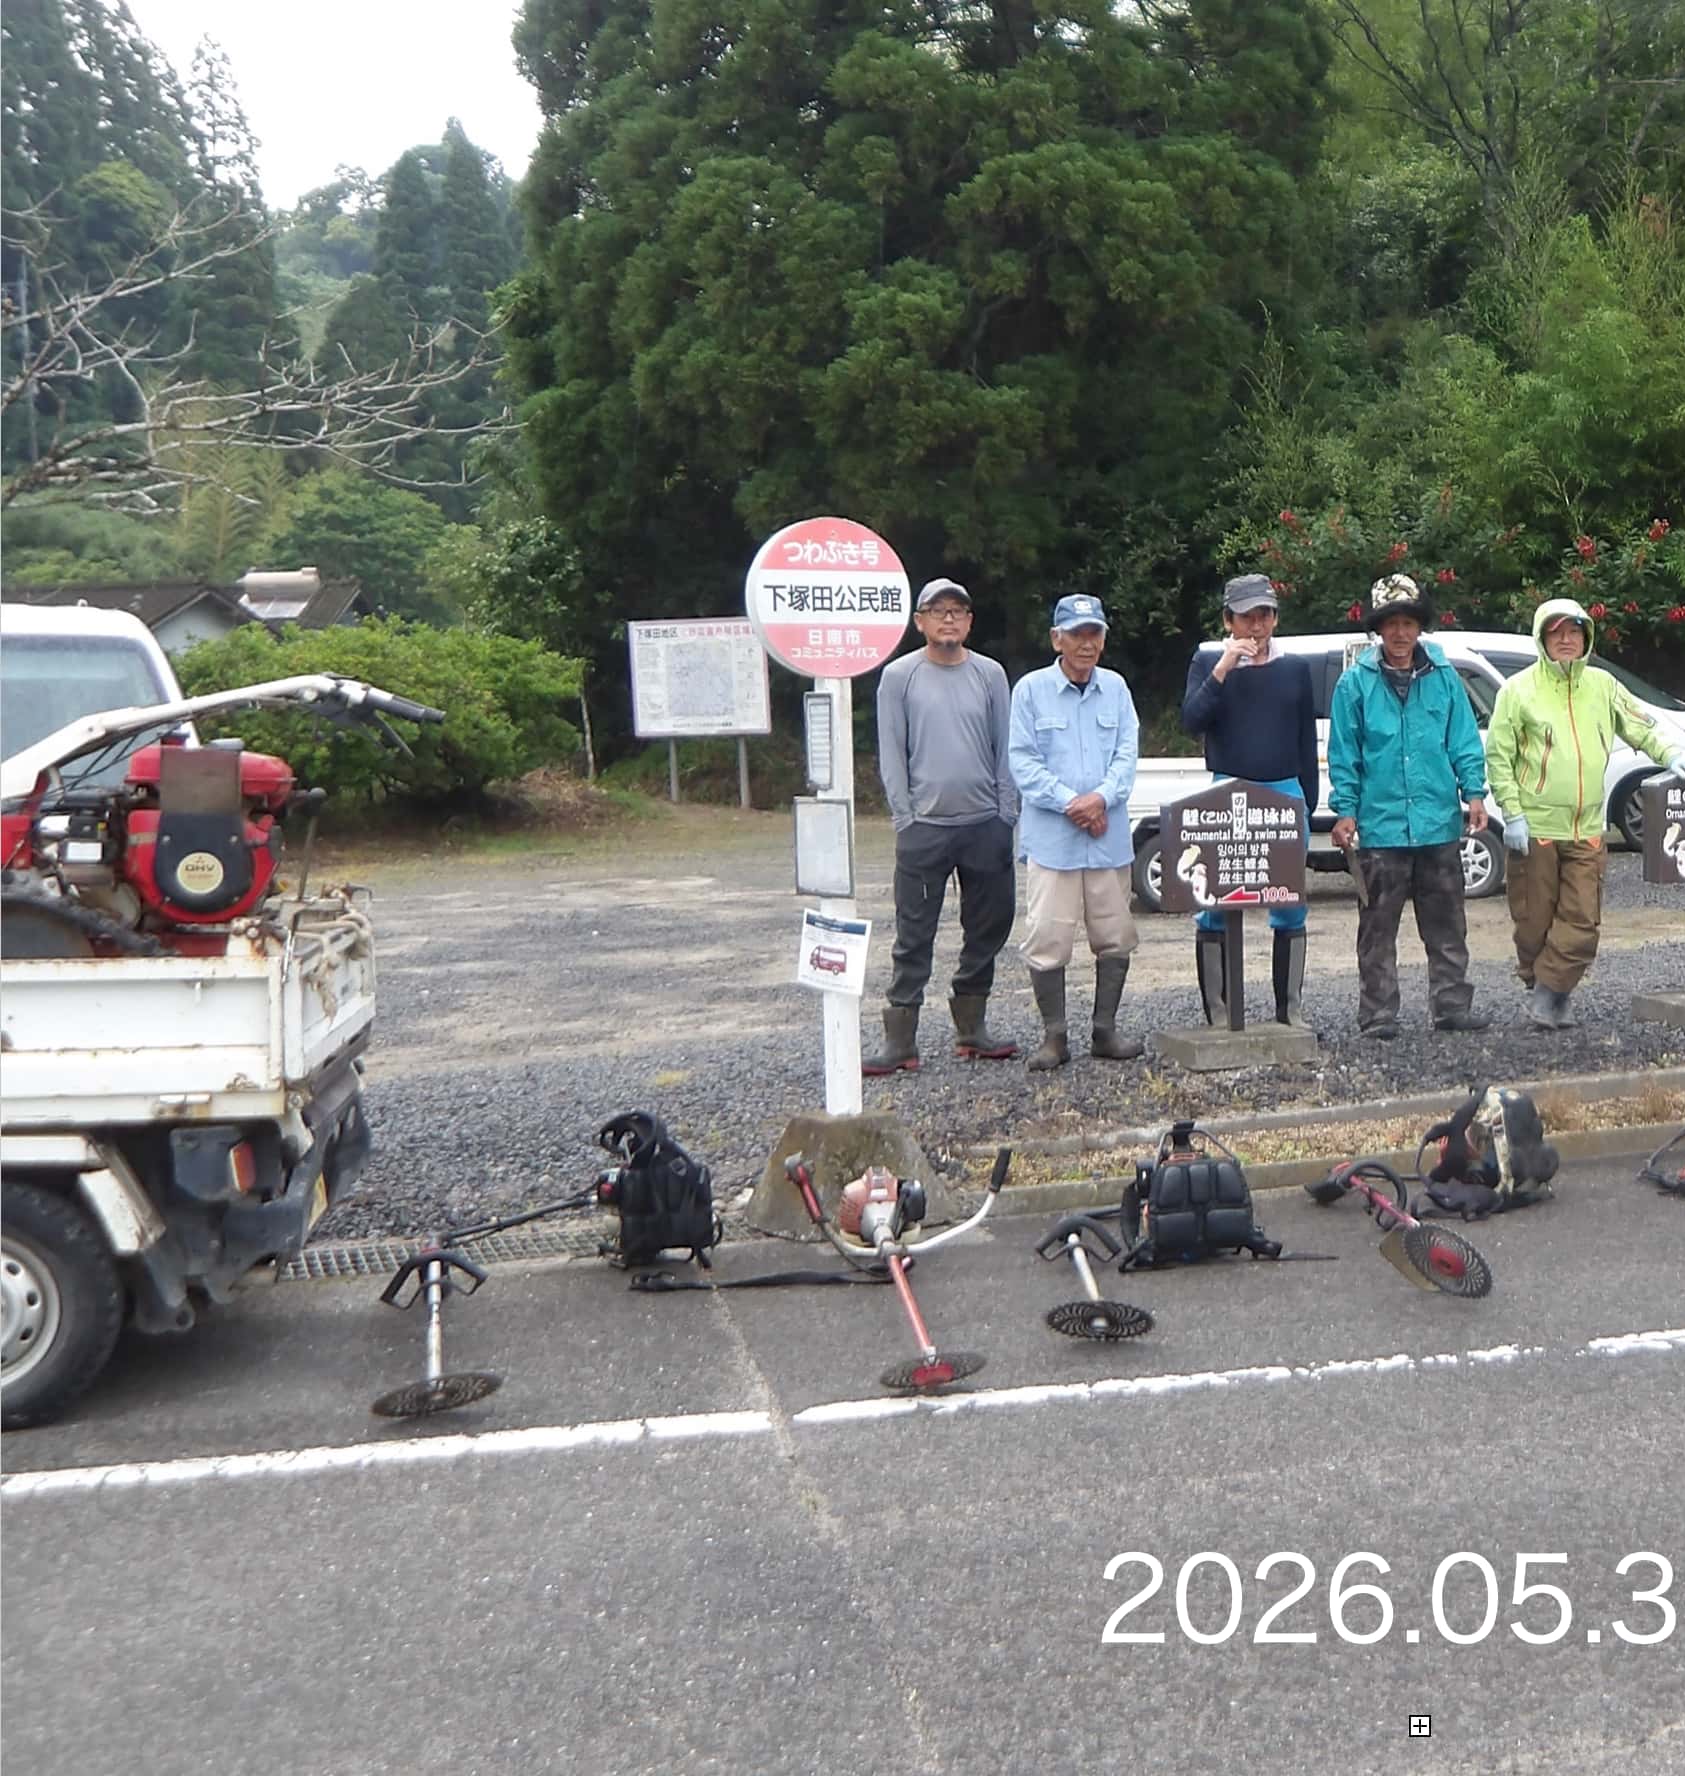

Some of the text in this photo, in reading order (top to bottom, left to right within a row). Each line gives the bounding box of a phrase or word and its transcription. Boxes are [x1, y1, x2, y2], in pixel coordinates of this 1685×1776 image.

[783, 539, 881, 565] つわぶき号
[763, 584, 902, 613] 下塚田公民館
[808, 629, 861, 644] 日南市
[791, 647, 879, 658] コミュニティバス
[1180, 829, 1231, 841] Ornamental
[1255, 828, 1277, 840] swim
[1279, 830, 1298, 840] zone
[1261, 886, 1300, 903] 100m
